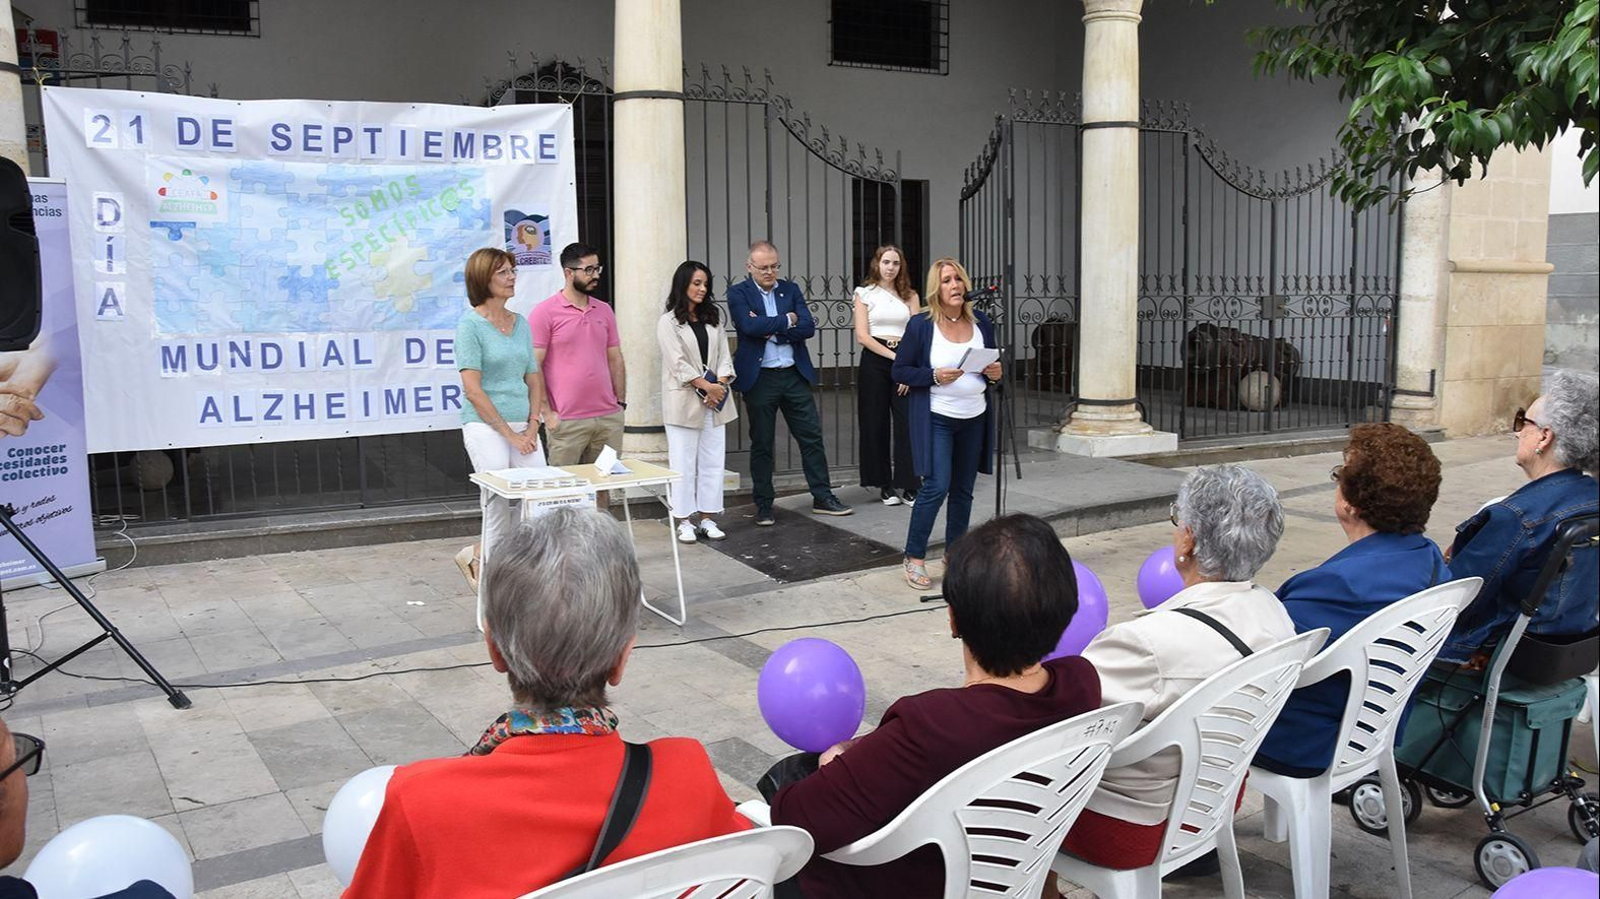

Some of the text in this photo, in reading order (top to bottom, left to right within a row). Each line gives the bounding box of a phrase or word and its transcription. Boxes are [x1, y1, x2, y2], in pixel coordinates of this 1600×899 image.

[91, 114, 557, 160] 21 DE SEPTIEMBRE
[31, 194, 49, 204] as
[340, 174, 423, 227] SOMOS
[97, 197, 124, 317] DÍA
[161, 338, 373, 374] MUNDIAL
[199, 384, 462, 424] ALZHEIMER
[7, 444, 67, 458] Conocer
[1, 465, 69, 482] colectivo
